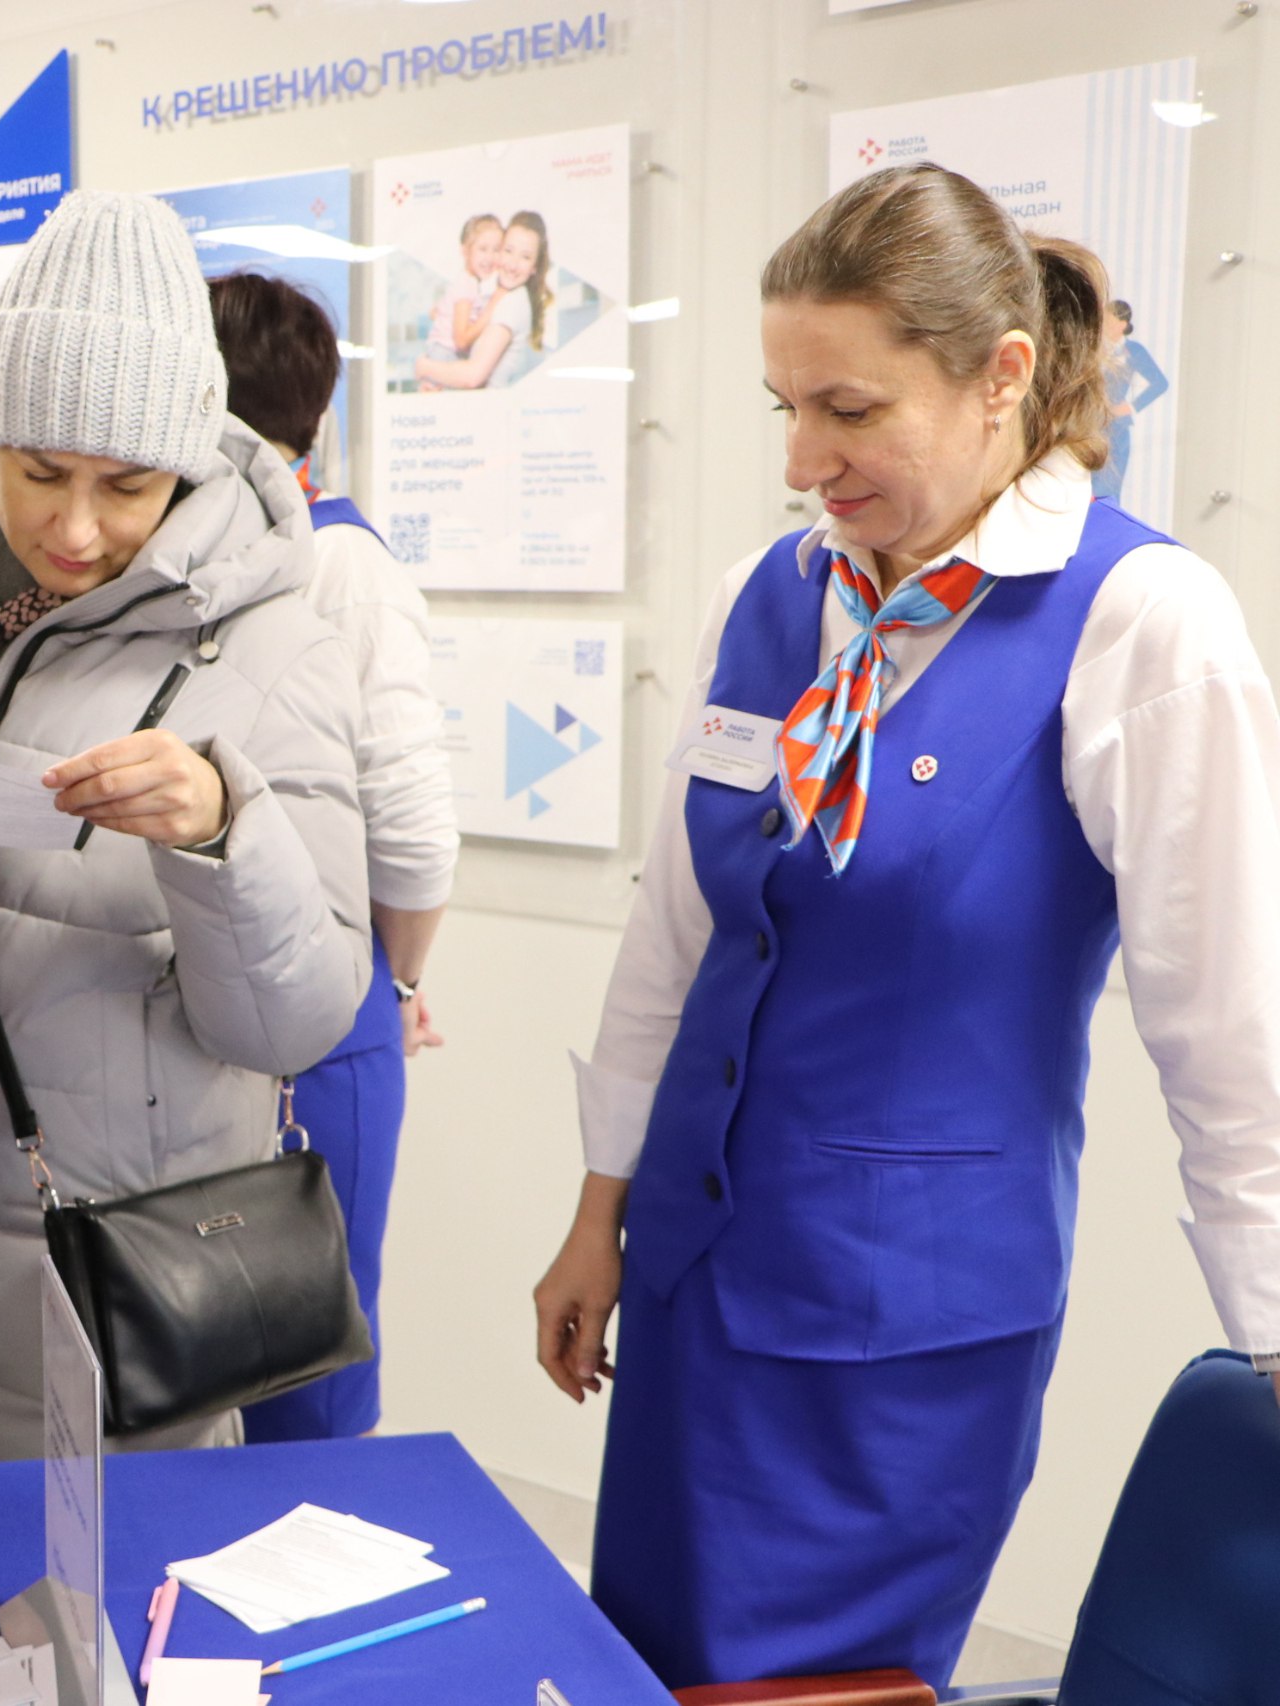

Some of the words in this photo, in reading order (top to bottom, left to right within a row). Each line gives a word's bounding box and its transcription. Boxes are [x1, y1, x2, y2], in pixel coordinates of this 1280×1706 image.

[143, 95, 162, 127] К
[173, 58, 368, 121] РЕШЕНИЮ
[381, 12, 608, 85] ПРОБЛЕМ!
[888, 136, 925, 148] РАБОТА
[888, 146, 928, 157] РОССИИ
[390, 414, 436, 428] Новая
[390, 434, 474, 452] профессия
[389, 458, 417, 473] для
[421, 457, 485, 471] женщин
[402, 479, 463, 494] декрете
[723, 730, 753, 742] РОССИИ
[728, 723, 755, 735] РАБОТА
